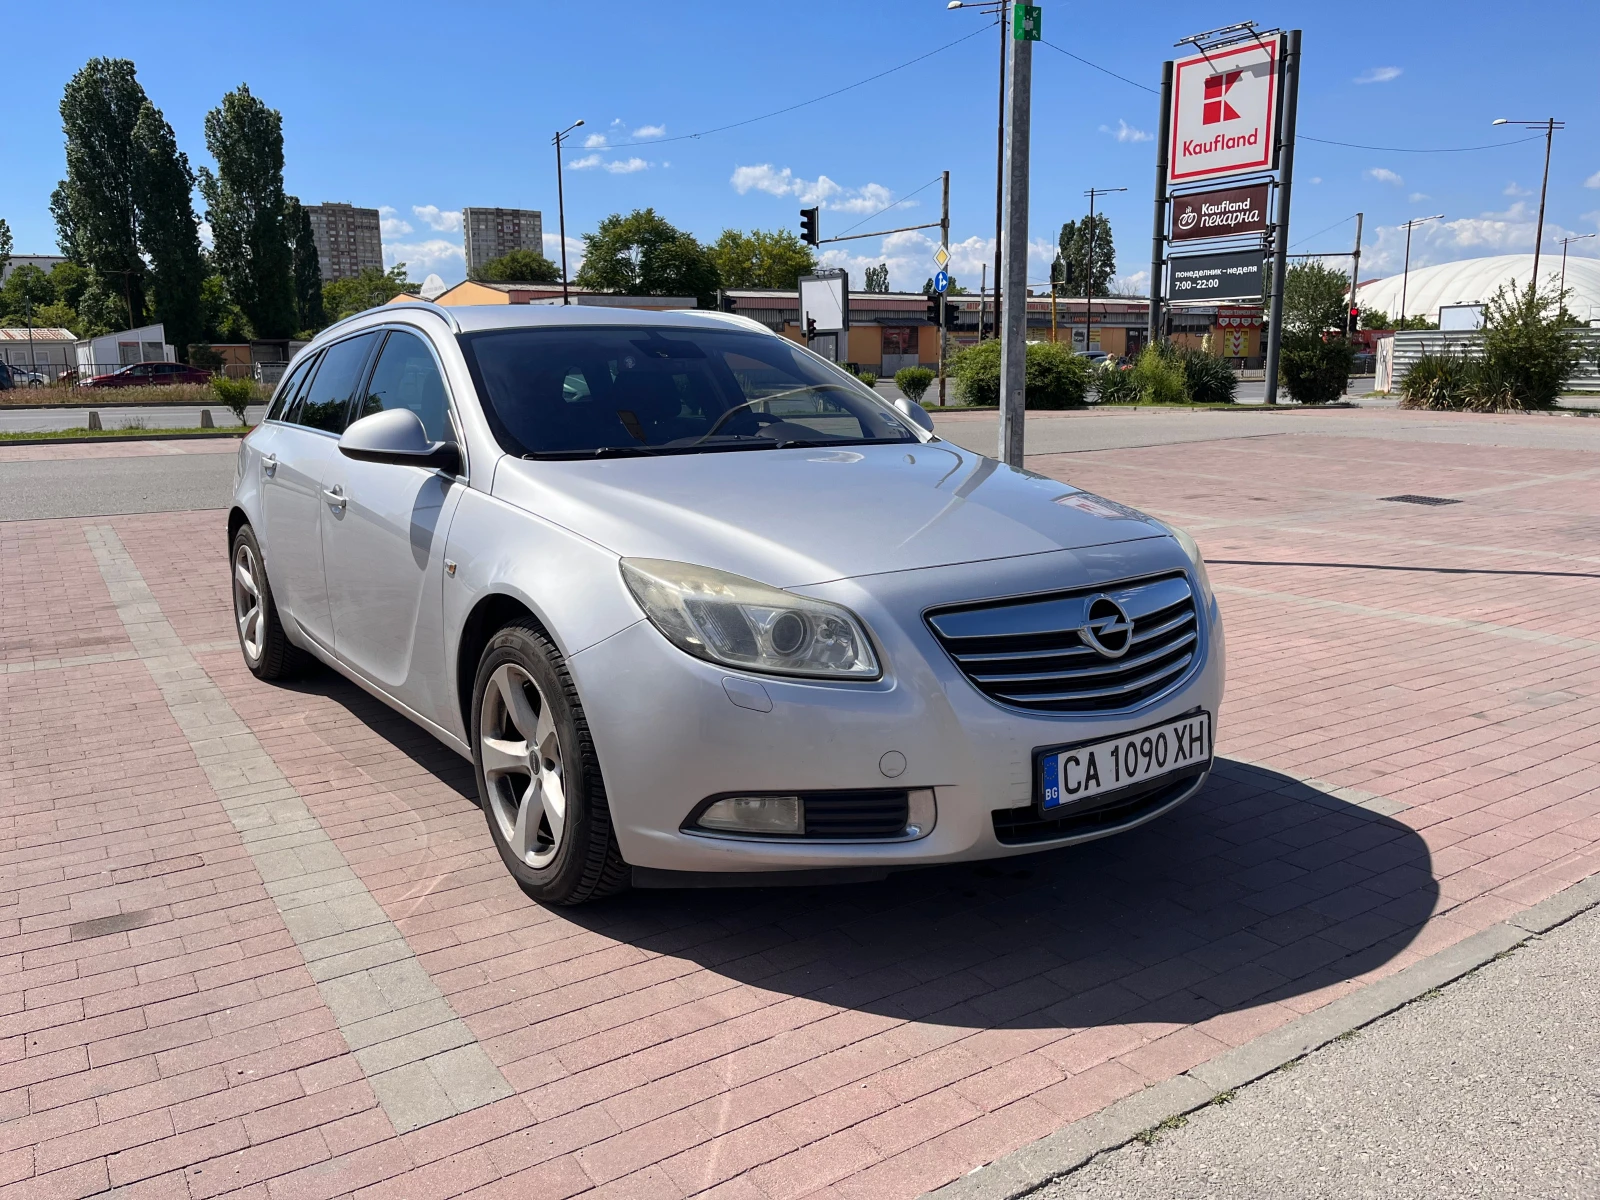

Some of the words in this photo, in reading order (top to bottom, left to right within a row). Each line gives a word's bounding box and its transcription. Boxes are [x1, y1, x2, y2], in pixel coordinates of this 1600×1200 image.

[1183, 128, 1258, 157] Kaufland
[1201, 198, 1250, 214] Kaufland
[1200, 210, 1260, 227] пекарна
[1063, 752, 1101, 795] CA
[1110, 731, 1168, 782] 1090
[1173, 720, 1204, 763] XH
[1045, 787, 1058, 801] BG
